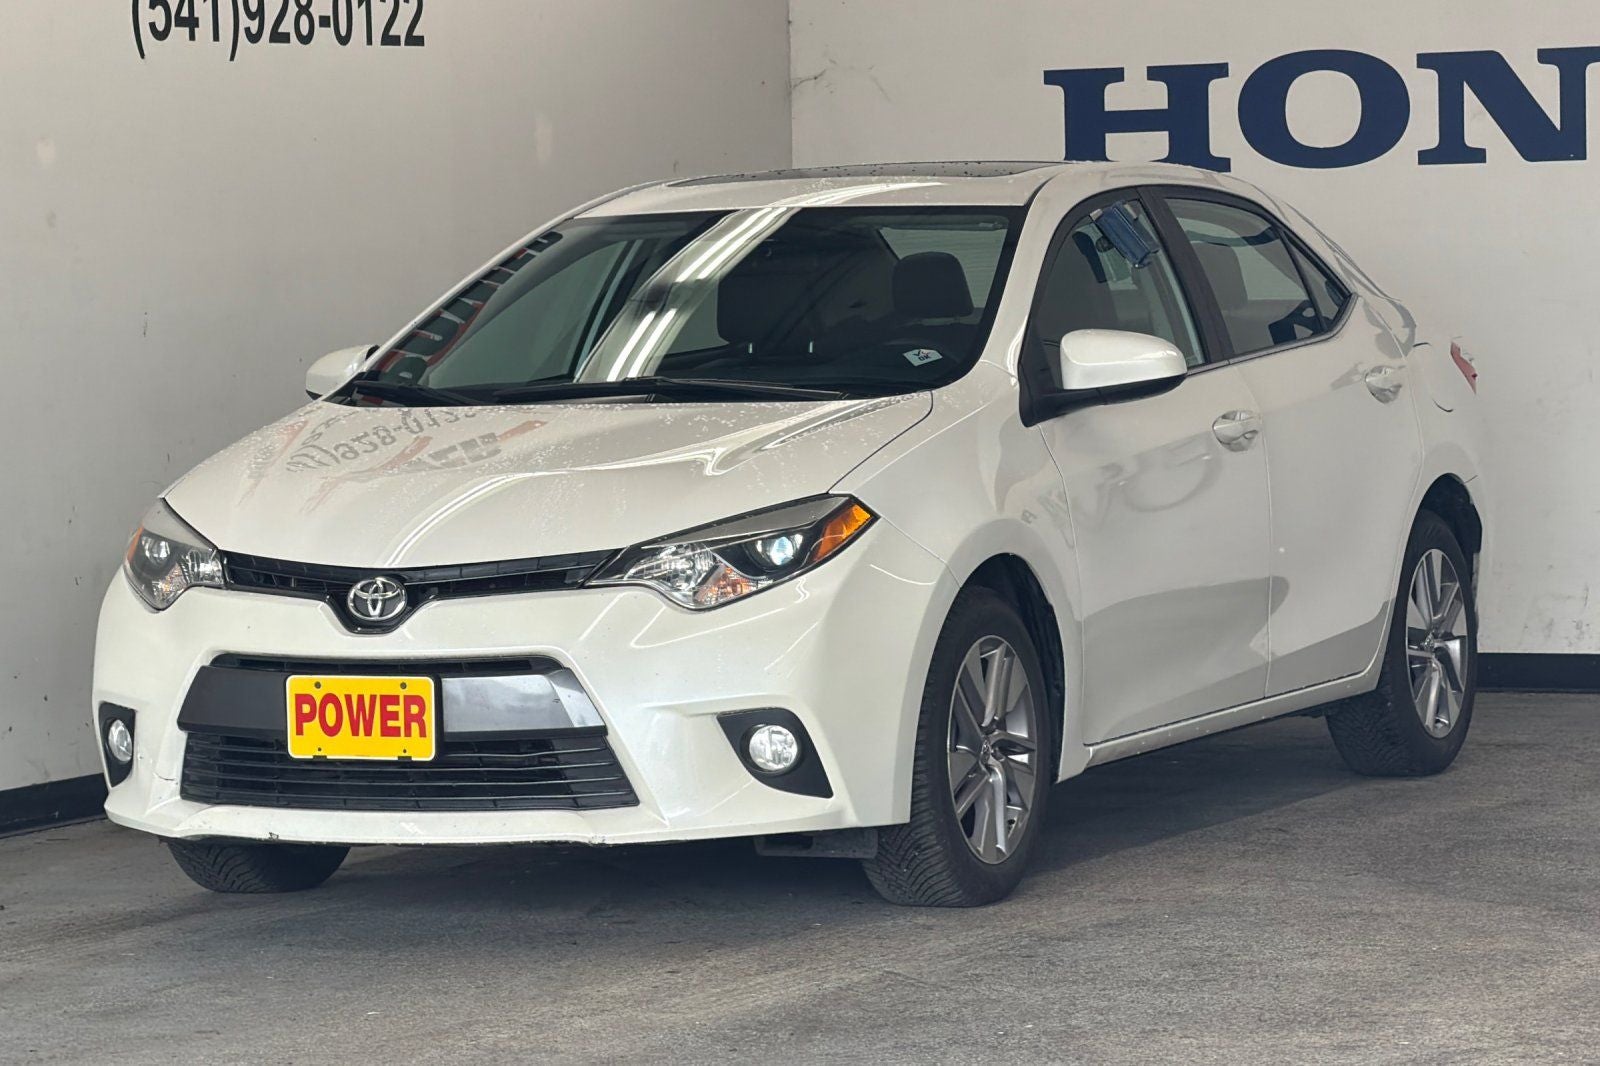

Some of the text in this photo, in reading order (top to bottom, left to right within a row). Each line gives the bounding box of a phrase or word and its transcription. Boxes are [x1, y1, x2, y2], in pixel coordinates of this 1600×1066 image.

[131, 0, 425, 61] (541)928-0122
[1043, 47, 1600, 172] HON
[294, 692, 427, 738] POWER
